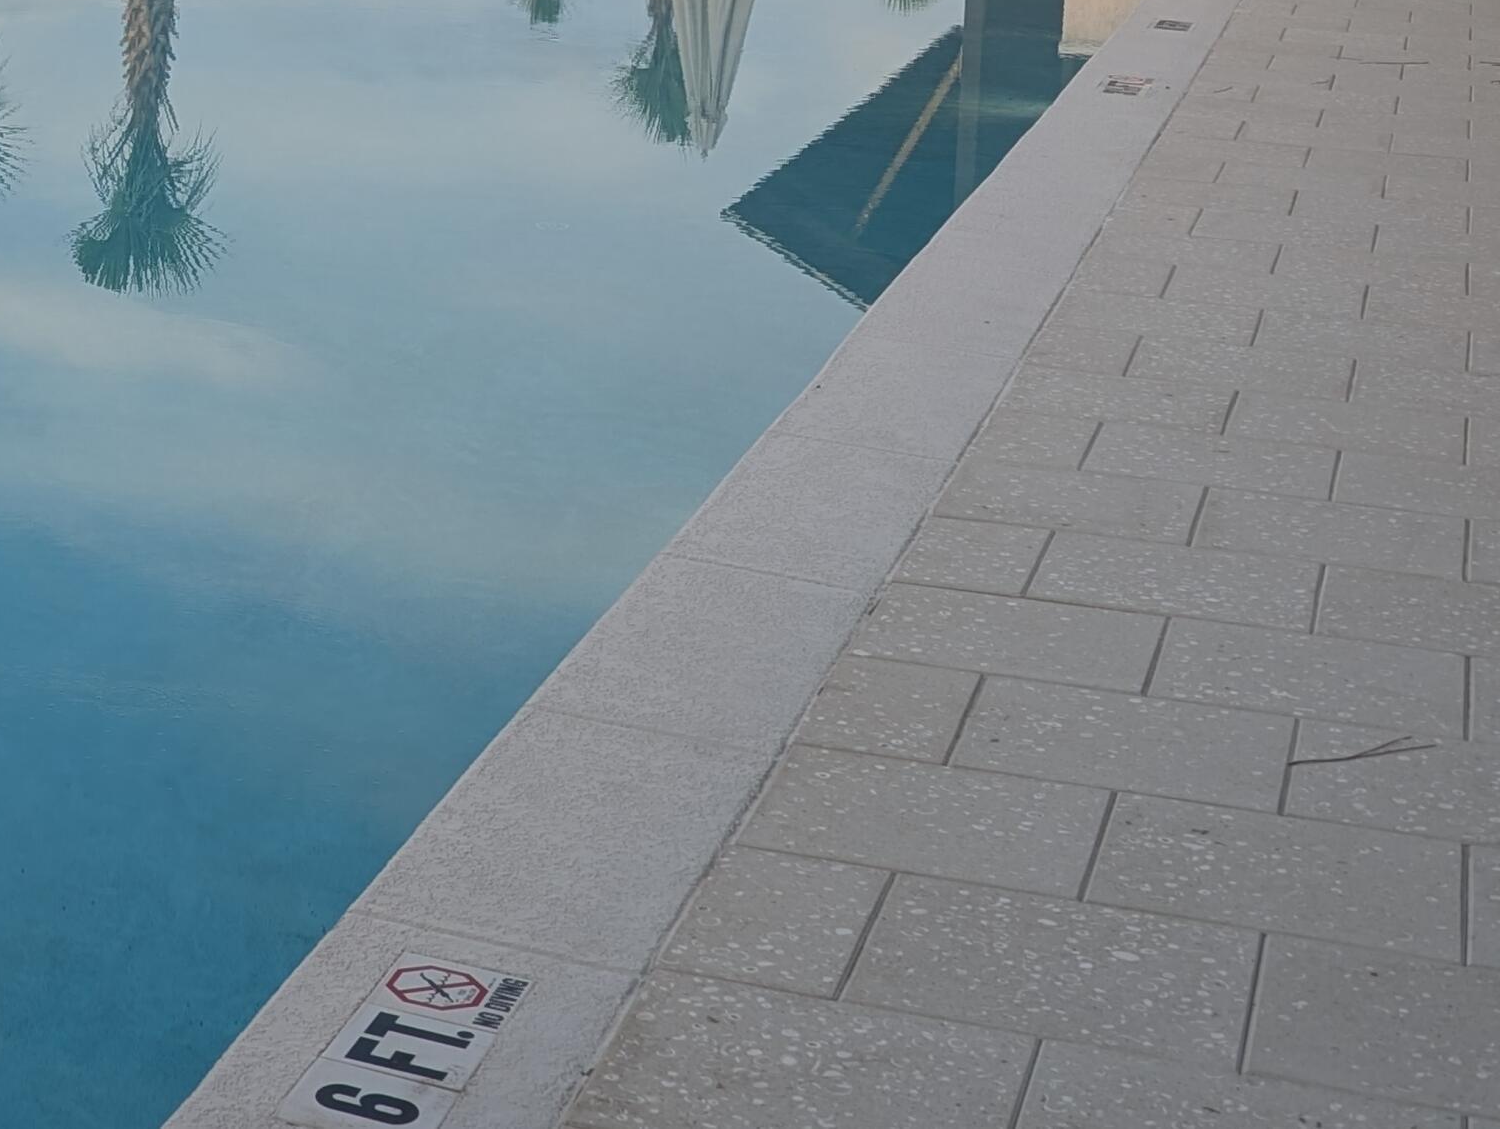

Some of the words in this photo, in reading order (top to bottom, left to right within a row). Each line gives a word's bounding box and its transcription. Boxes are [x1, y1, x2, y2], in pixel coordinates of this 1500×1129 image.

[483, 977, 530, 1013] DIVING
[472, 1011, 505, 1030] NO
[345, 1011, 475, 1082] FT.
[315, 1083, 420, 1126] 6
